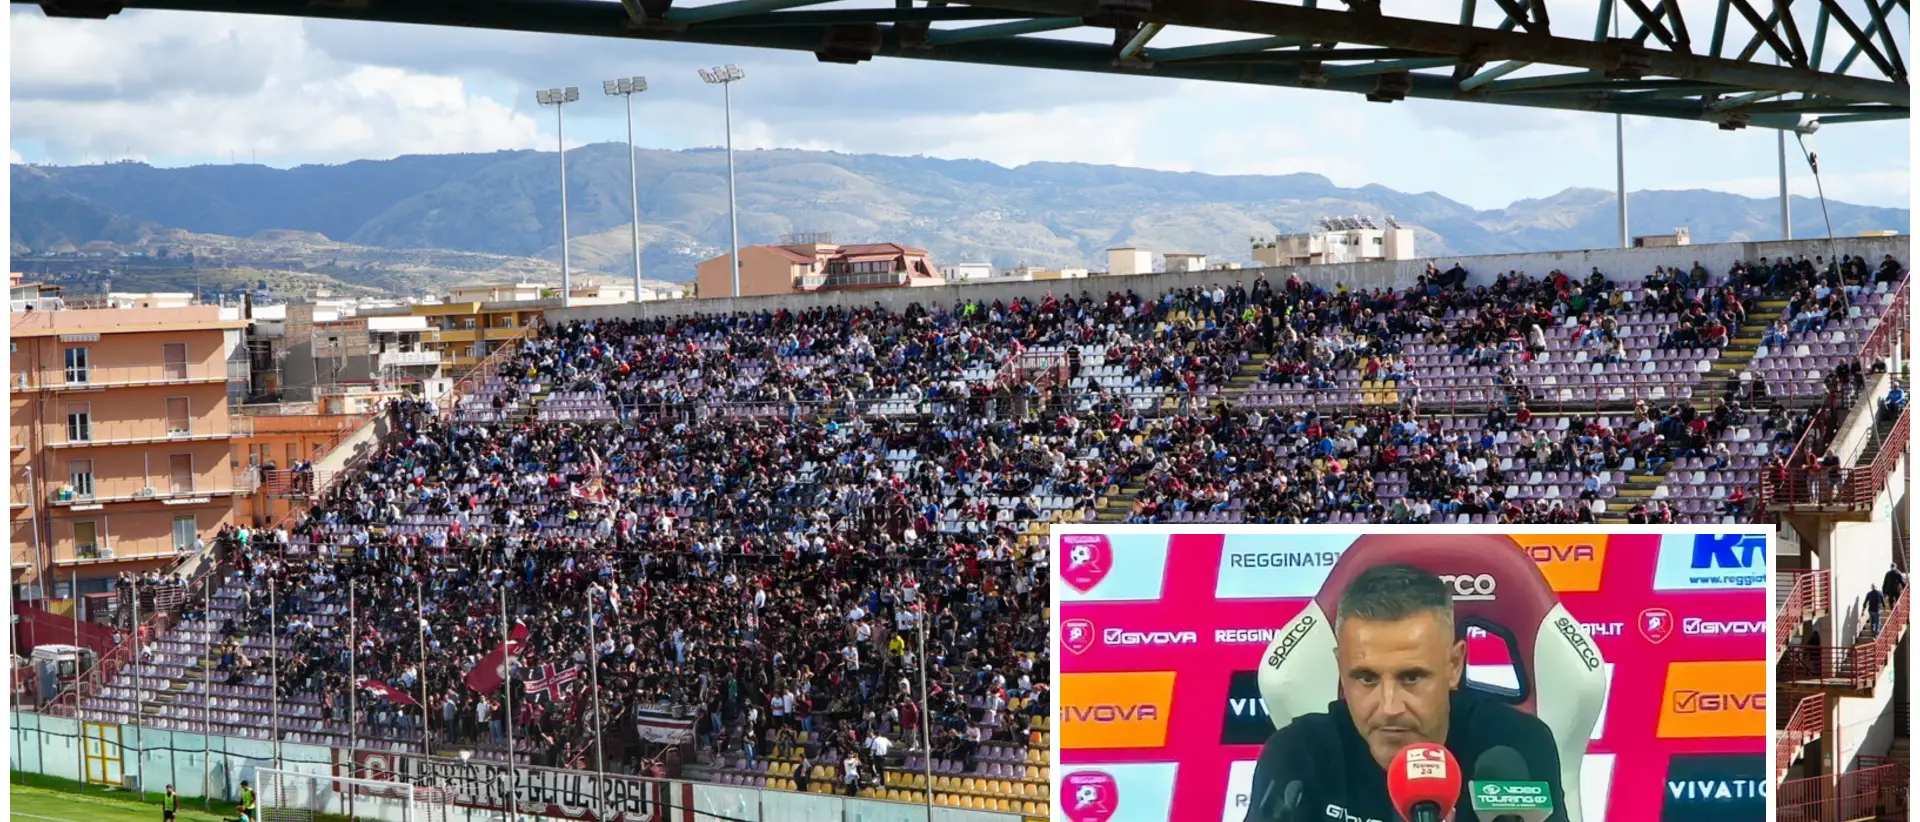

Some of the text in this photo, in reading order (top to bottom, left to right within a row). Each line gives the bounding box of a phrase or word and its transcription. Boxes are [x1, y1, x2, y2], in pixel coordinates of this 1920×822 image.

[1121, 632, 1197, 644] GIVOVA
[1268, 615, 1317, 670] sparco
[1554, 617, 1600, 672] sparco
